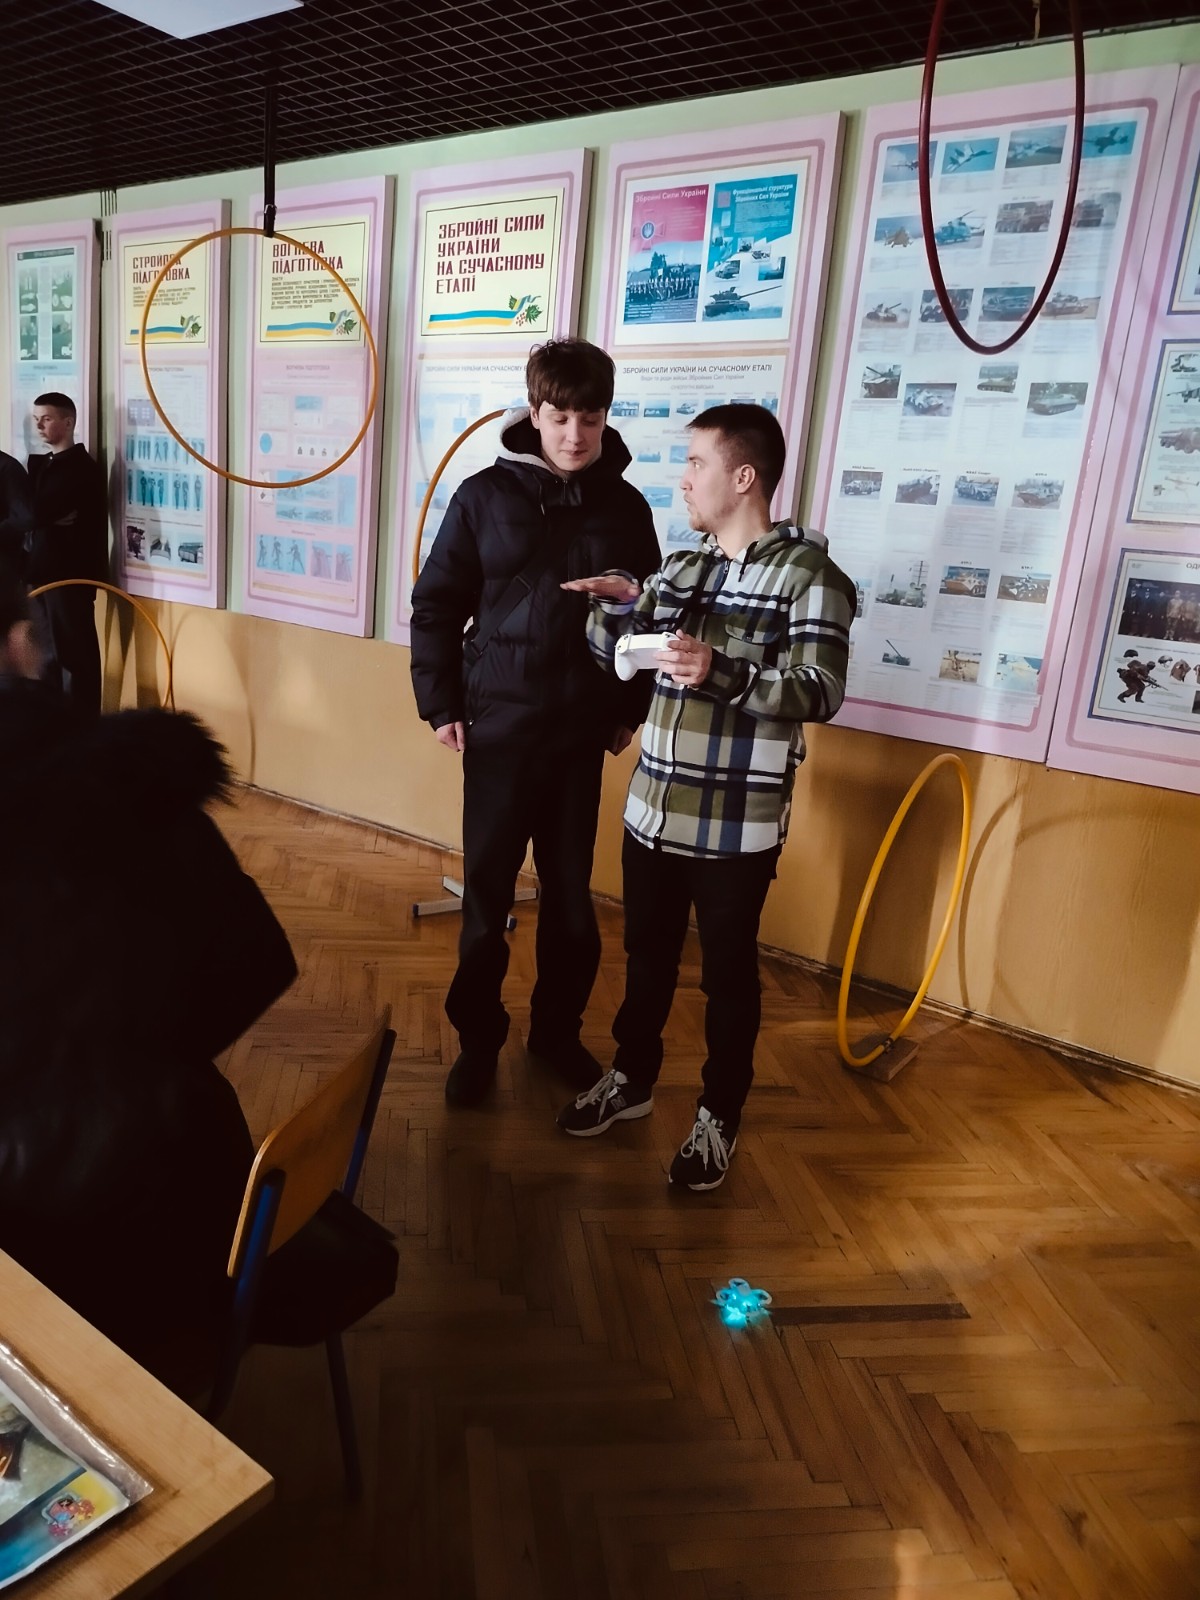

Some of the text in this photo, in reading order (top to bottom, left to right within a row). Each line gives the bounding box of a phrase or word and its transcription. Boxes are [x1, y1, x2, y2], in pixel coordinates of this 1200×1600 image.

[681, 189, 706, 198] України
[439, 214, 545, 240] ЗБРОЙНІ СИЛИ
[438, 237, 500, 257] УКРАЇНИ
[437, 253, 545, 276] НА СУЧАСНОМУ
[436, 275, 476, 294] ЕТАПІ
[622, 366, 650, 374] ЗБРОЙНІ
[650, 366, 669, 374] СИЛИ
[669, 365, 697, 373] УКРАЇНИ
[708, 364, 751, 373] СУЧАСНОМУ
[752, 363, 772, 372] ЕТАПІ
